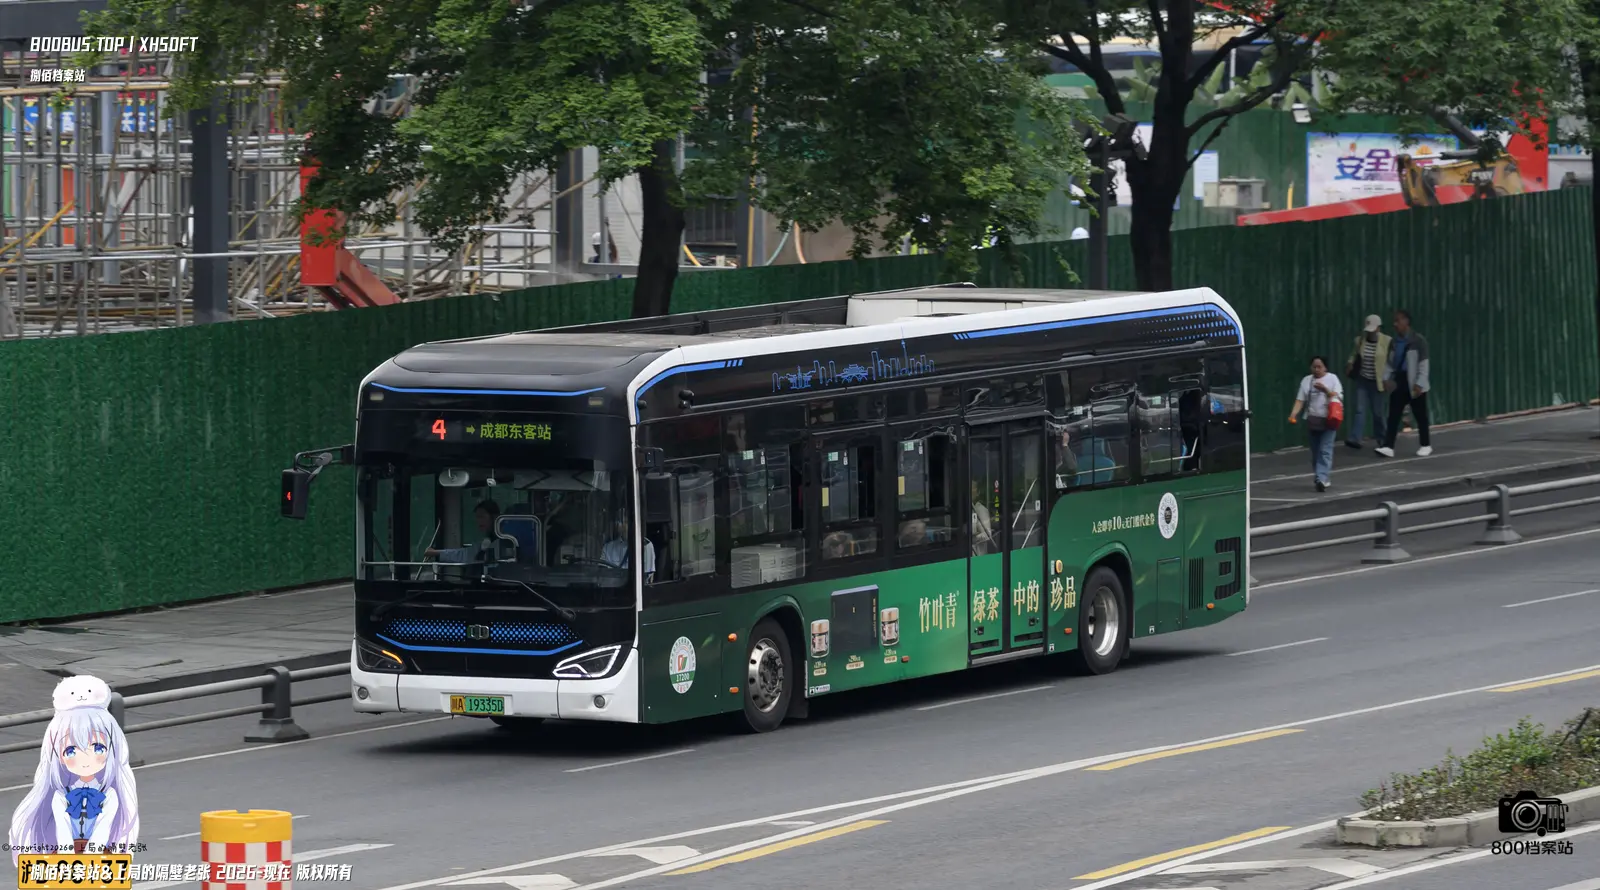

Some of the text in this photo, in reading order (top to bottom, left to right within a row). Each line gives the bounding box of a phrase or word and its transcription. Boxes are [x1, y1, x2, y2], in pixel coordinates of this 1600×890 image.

[432, 419, 552, 441] 4 成都东客站
[919, 592, 957, 633] 竹叶青
